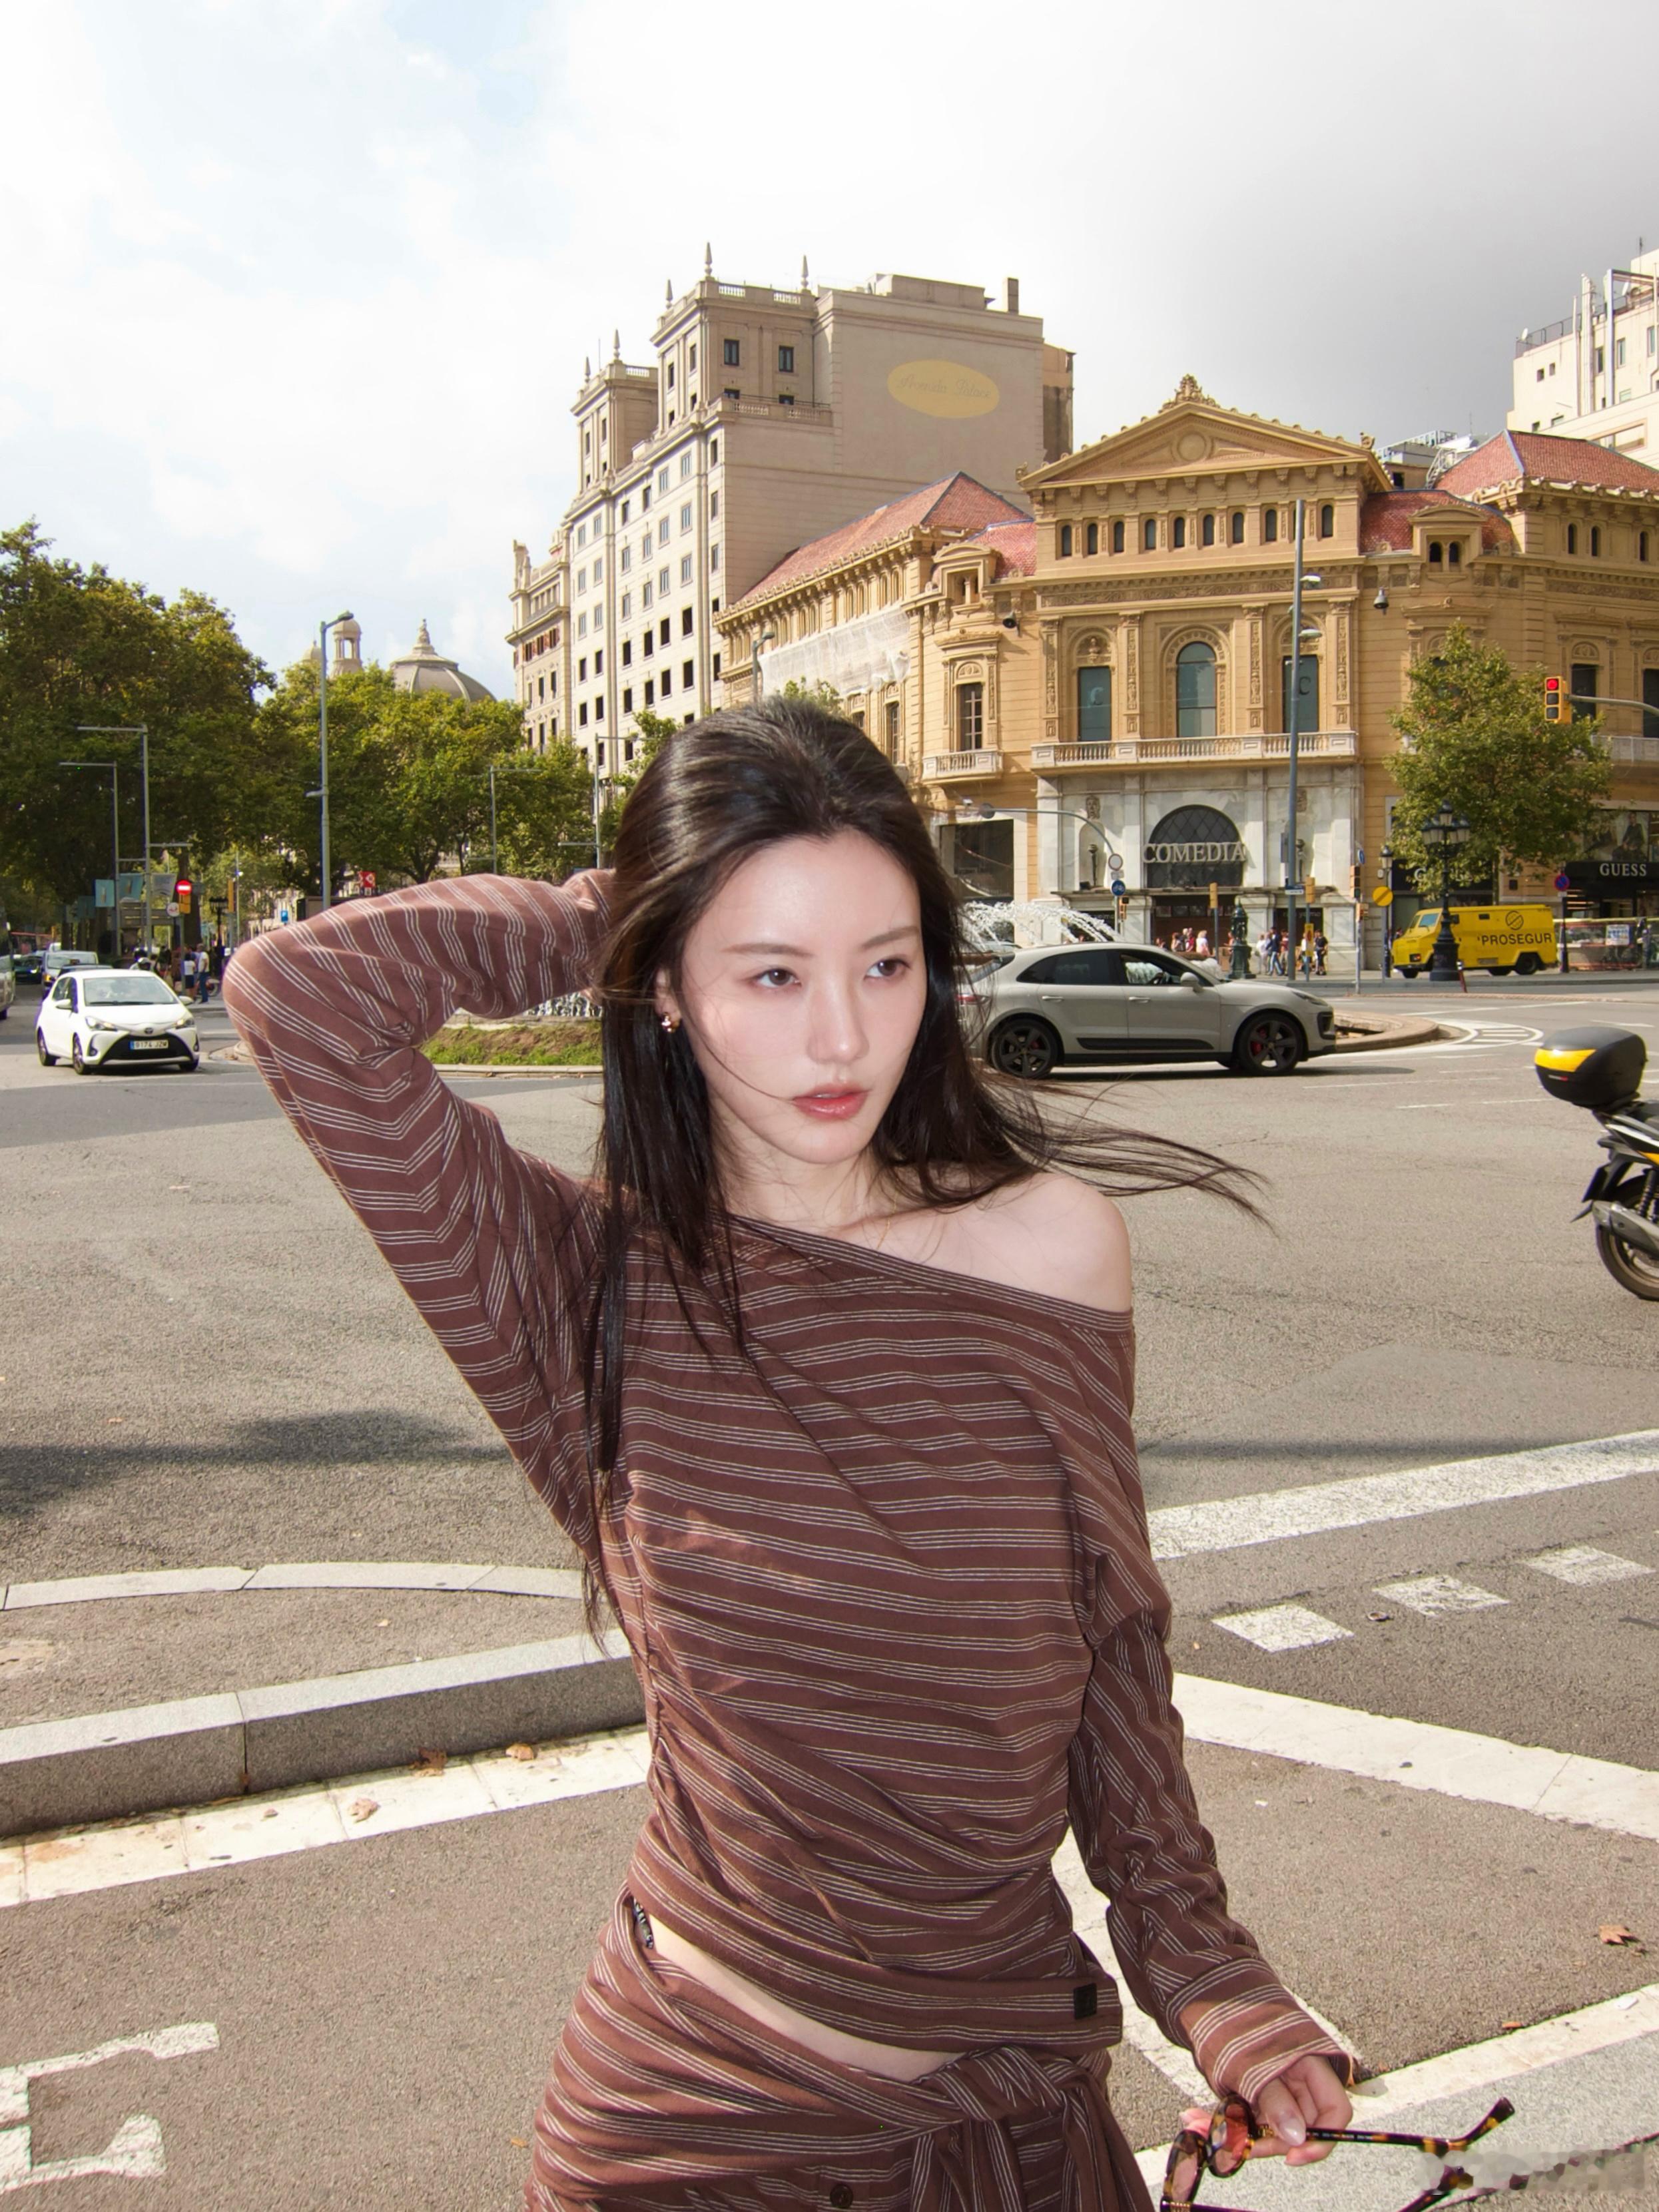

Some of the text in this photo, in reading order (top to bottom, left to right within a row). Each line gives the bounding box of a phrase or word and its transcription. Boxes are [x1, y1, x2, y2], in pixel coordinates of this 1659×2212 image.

[1142, 841, 1247, 864] COMEDIA
[1599, 862, 1647, 877] GUESS
[1481, 933, 1552, 946] PROSEGUR
